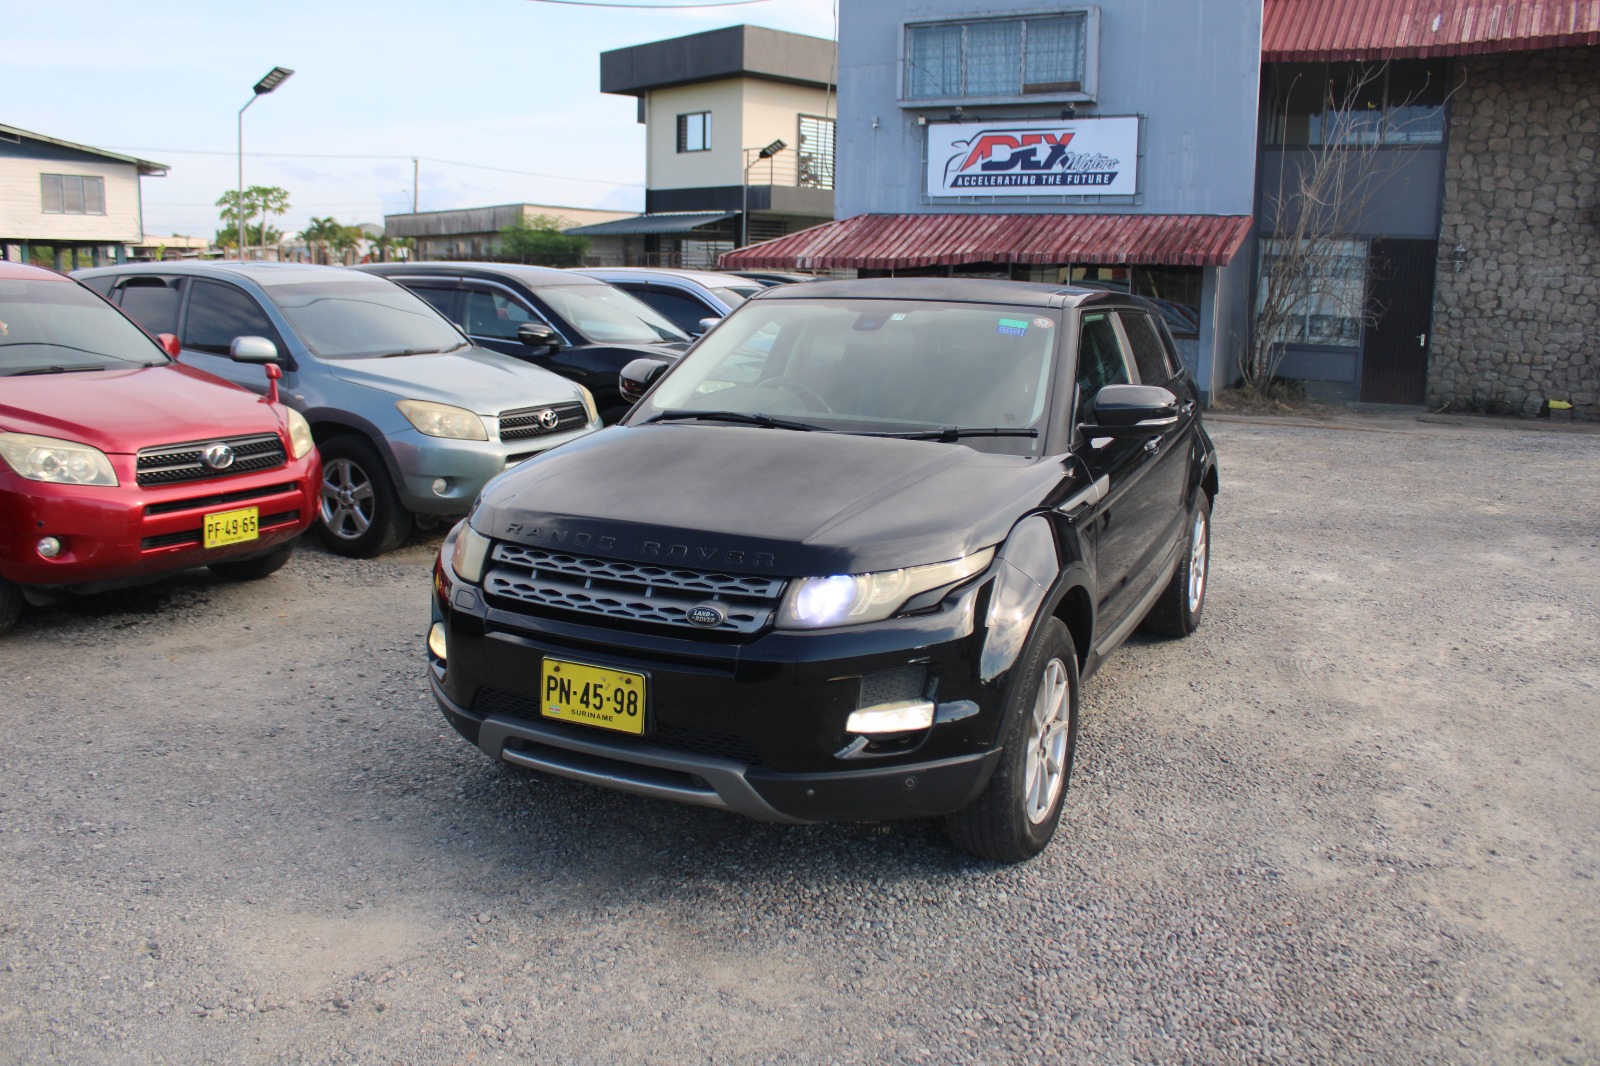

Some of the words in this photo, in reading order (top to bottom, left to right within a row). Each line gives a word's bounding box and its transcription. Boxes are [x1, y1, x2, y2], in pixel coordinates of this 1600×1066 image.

[960, 132, 1076, 172] ADEX
[1056, 151, 1120, 174] Motors
[957, 174, 1036, 186] ACCELERATING
[1042, 174, 1061, 185] THE
[1067, 173, 1110, 184] FUTURE
[207, 515, 256, 540] PF-49-65
[641, 541, 775, 567] ROVER
[546, 675, 638, 717] PN-45-98
[571, 708, 614, 723] SURINAME
